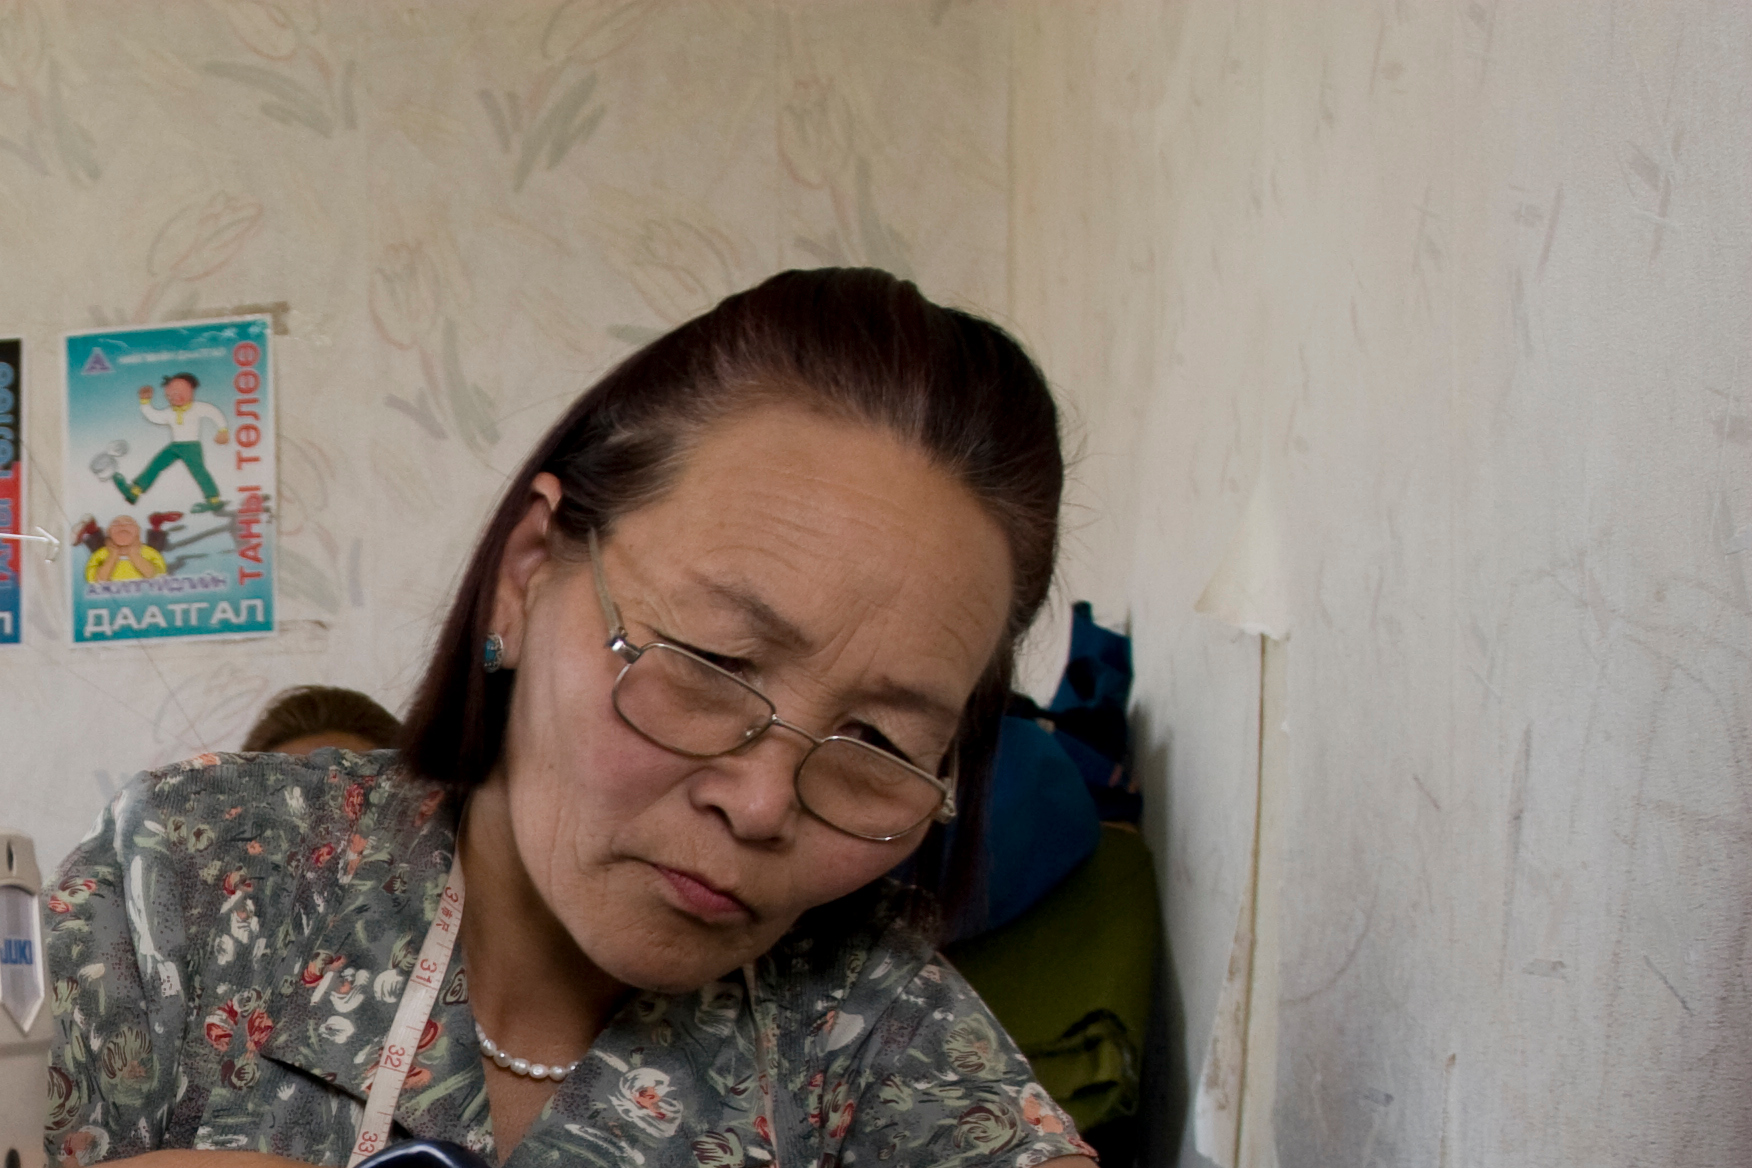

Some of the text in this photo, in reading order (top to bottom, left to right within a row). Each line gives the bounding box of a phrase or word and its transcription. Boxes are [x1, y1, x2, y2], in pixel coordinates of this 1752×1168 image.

[233, 341, 264, 586] ТАНЫ ТӨЛӨӨ
[84, 598, 265, 638] ДААТГАЛ
[0, 938, 33, 965] JUKI
[415, 958, 438, 984] 31
[384, 1044, 406, 1068] 32
[358, 1131, 379, 1154] 33
